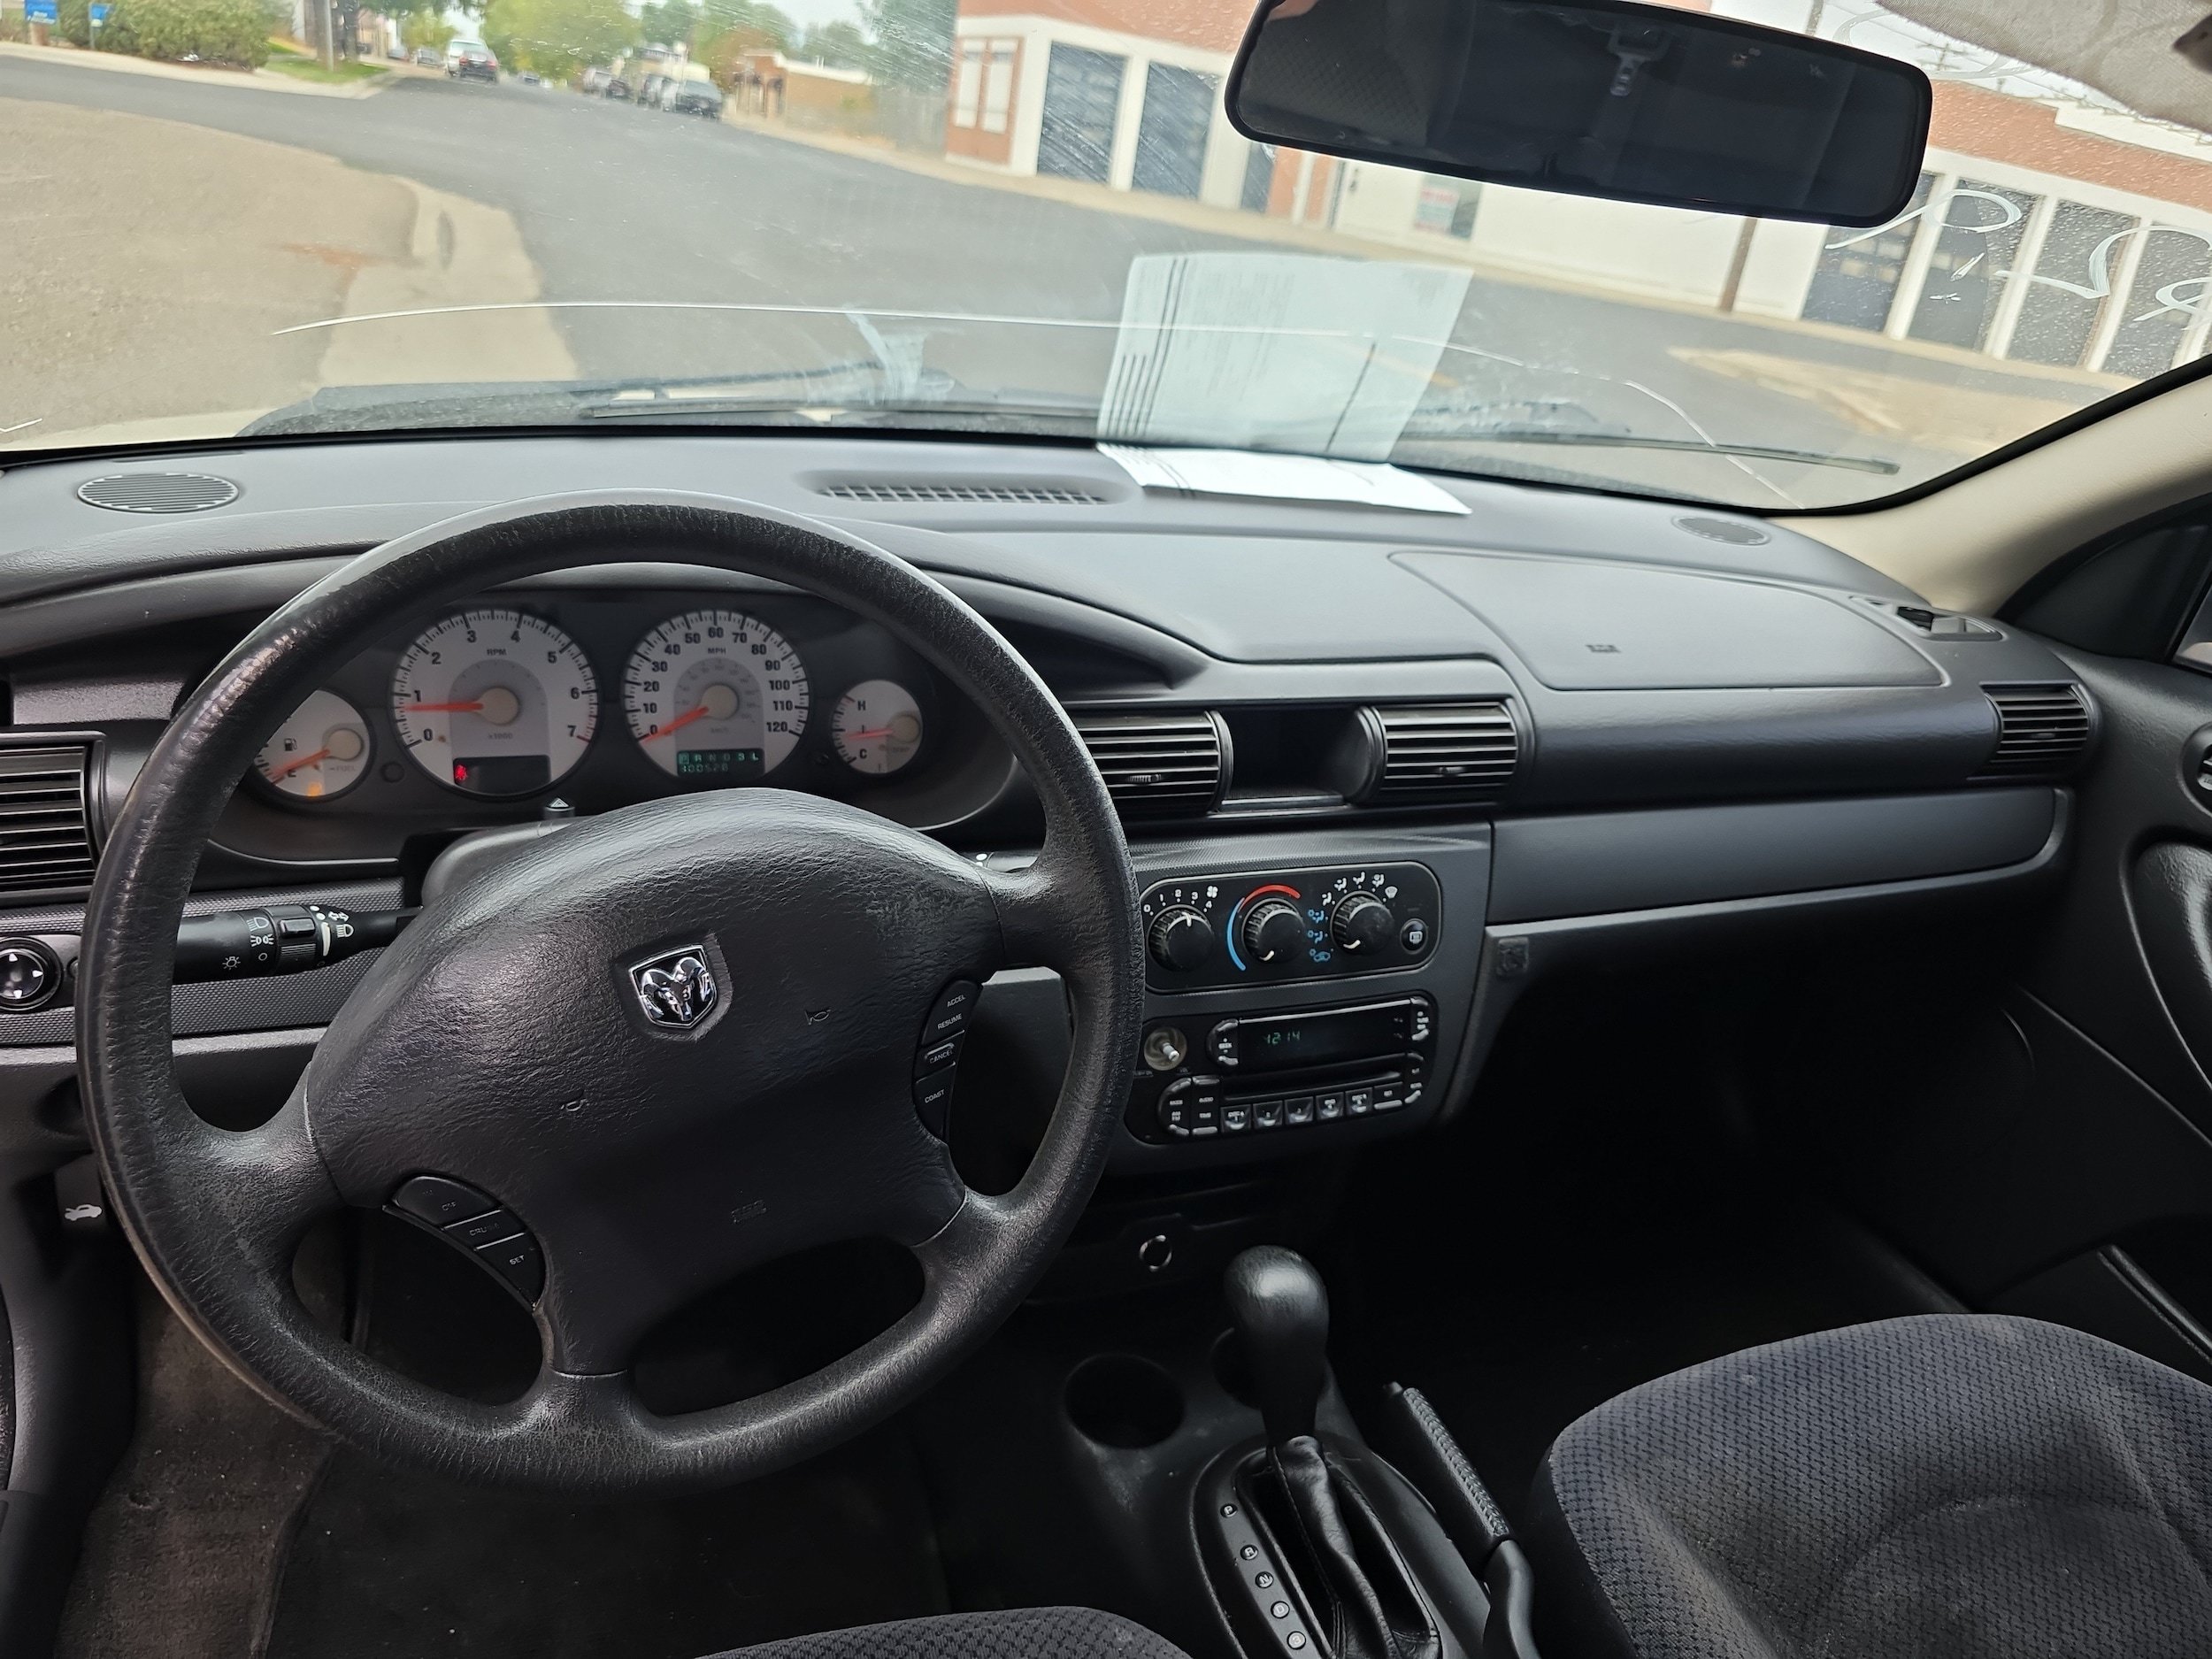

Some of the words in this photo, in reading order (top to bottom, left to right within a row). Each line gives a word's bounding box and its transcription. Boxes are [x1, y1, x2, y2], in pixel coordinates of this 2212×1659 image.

[467, 630, 477, 643] 3
[511, 629, 520, 642] 4
[685, 633, 701, 644] 50
[708, 626, 724, 639] 60
[732, 632, 748, 644] 70
[664, 643, 681, 656] 40
[751, 643, 767, 656] 80
[431, 651, 442, 664] 2
[547, 650, 557, 664] 5
[651, 660, 668, 672] 30
[764, 659, 781, 672] 90
[643, 680, 660, 693] 20
[769, 680, 791, 691] 100
[414, 689, 422, 703] 1
[570, 687, 580, 700] 6
[643, 703, 657, 714] 10
[772, 700, 794, 711] 110
[857, 700, 866, 711] H
[567, 725, 577, 737] 7
[649, 724, 658, 735] 0
[766, 721, 788, 733] 120
[423, 728, 434, 741] 0
[751, 751, 759, 761] L
[859, 749, 867, 759] C
[1159, 894, 1164, 902] 1
[1174, 888, 1182, 898] 2
[1191, 891, 1199, 900] 3
[1143, 903, 1151, 913] 0
[947, 994, 966, 1008] ACCEL
[937, 1013, 963, 1031] RESUME
[929, 1048, 953, 1064] CANCEL
[924, 1088, 945, 1104] COAST
[509, 1254, 526, 1265] SET
[1224, 1505, 1233, 1515] P
[1244, 1547, 1255, 1557] R
[1259, 1573, 1270, 1586] N
[1277, 1605, 1286, 1615] D
